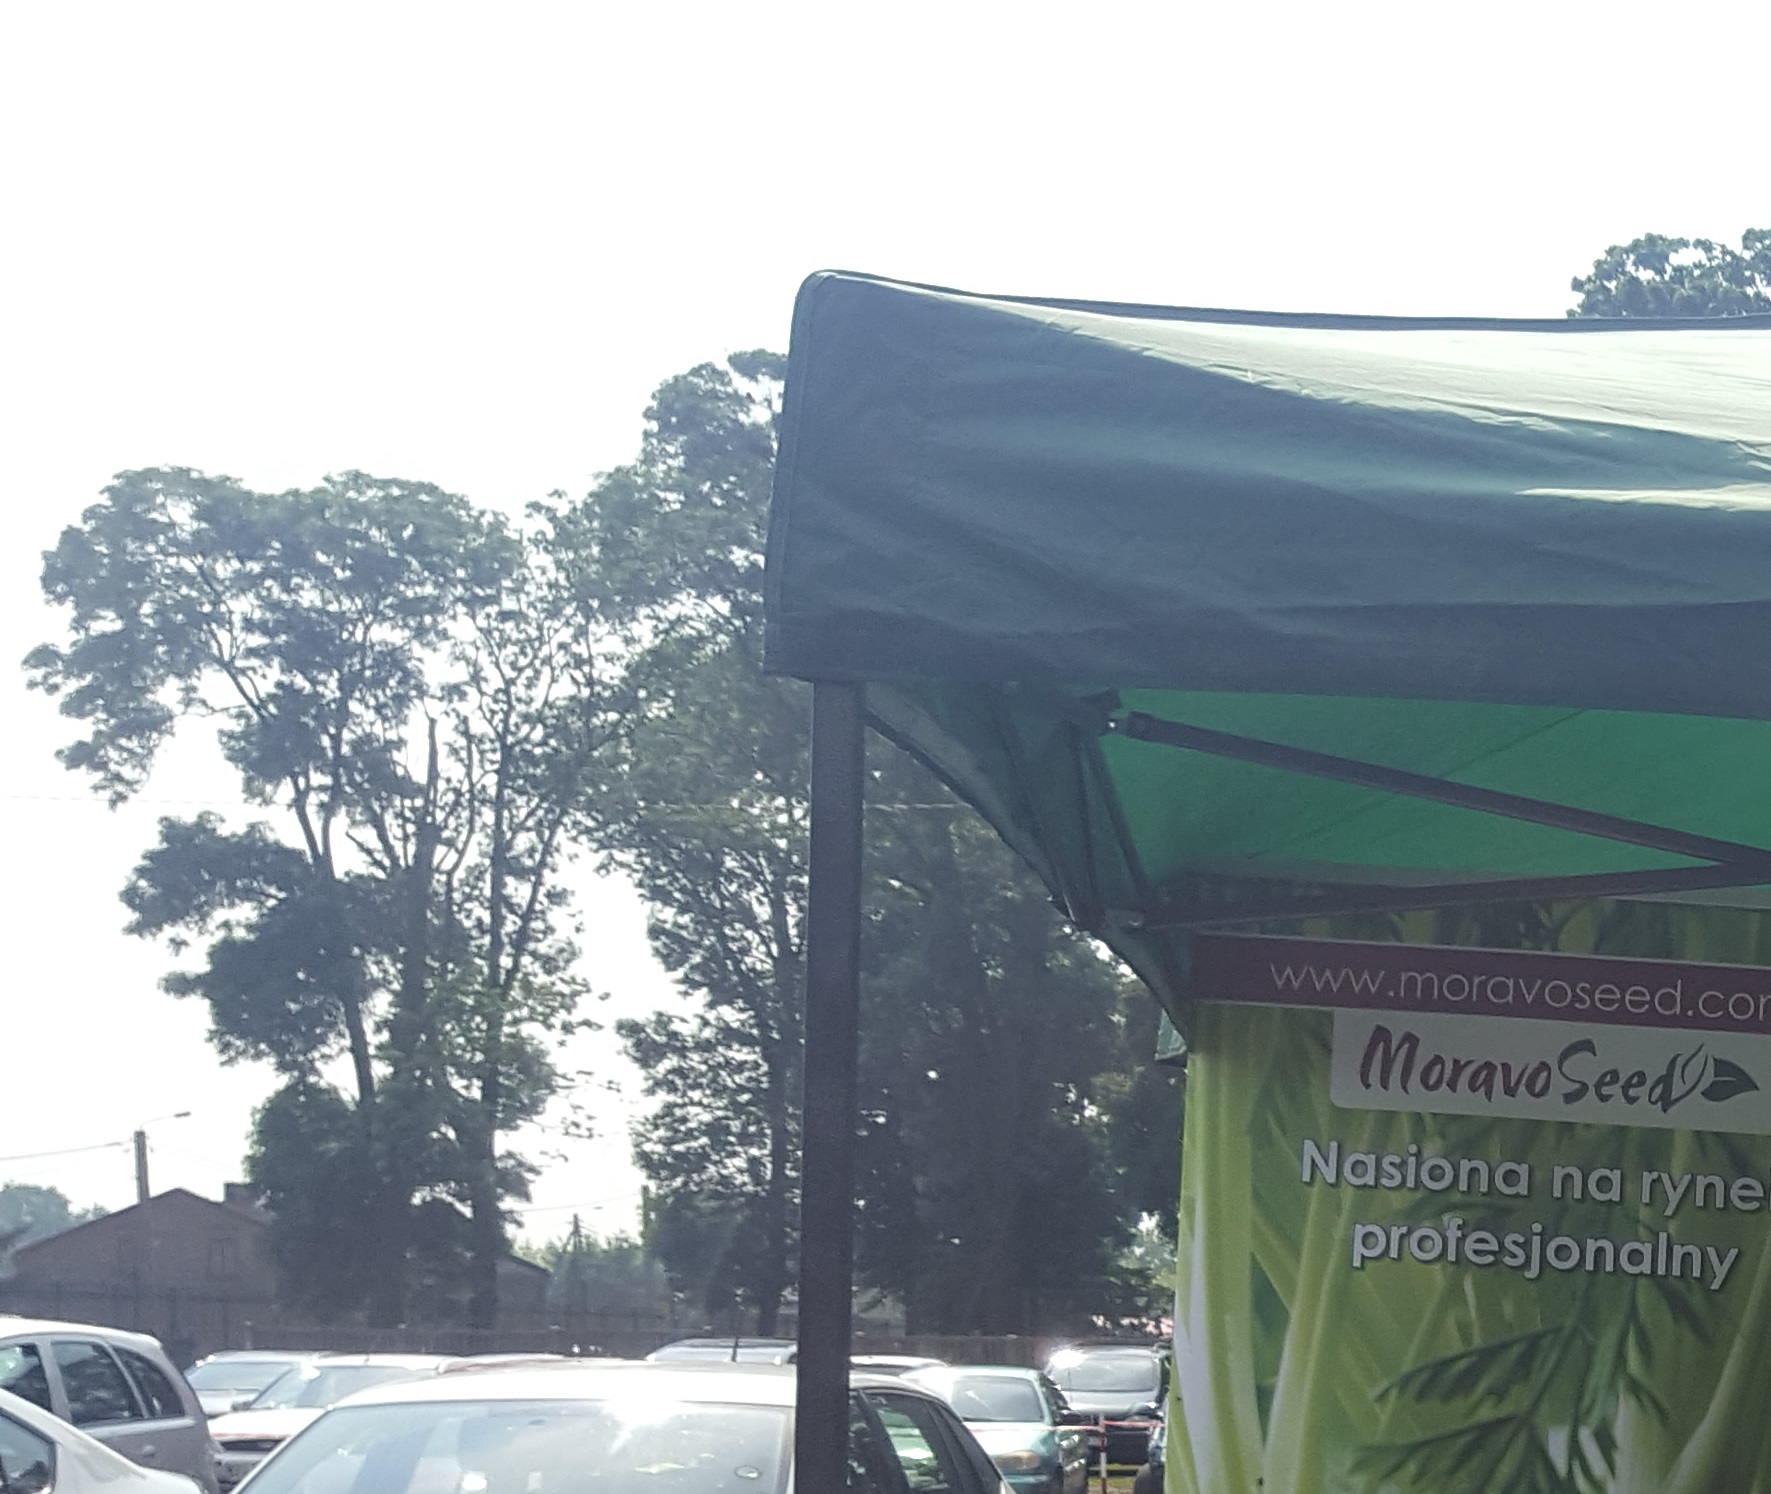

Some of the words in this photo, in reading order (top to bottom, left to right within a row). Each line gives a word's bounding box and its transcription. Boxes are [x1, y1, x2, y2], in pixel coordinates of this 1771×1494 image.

[1358, 1022, 1710, 1114] MoravoSeed
[1301, 1139, 1530, 1198] Nasiona
[1552, 1162, 1624, 1204] na
[1351, 1217, 1740, 1291] profesjonalny
